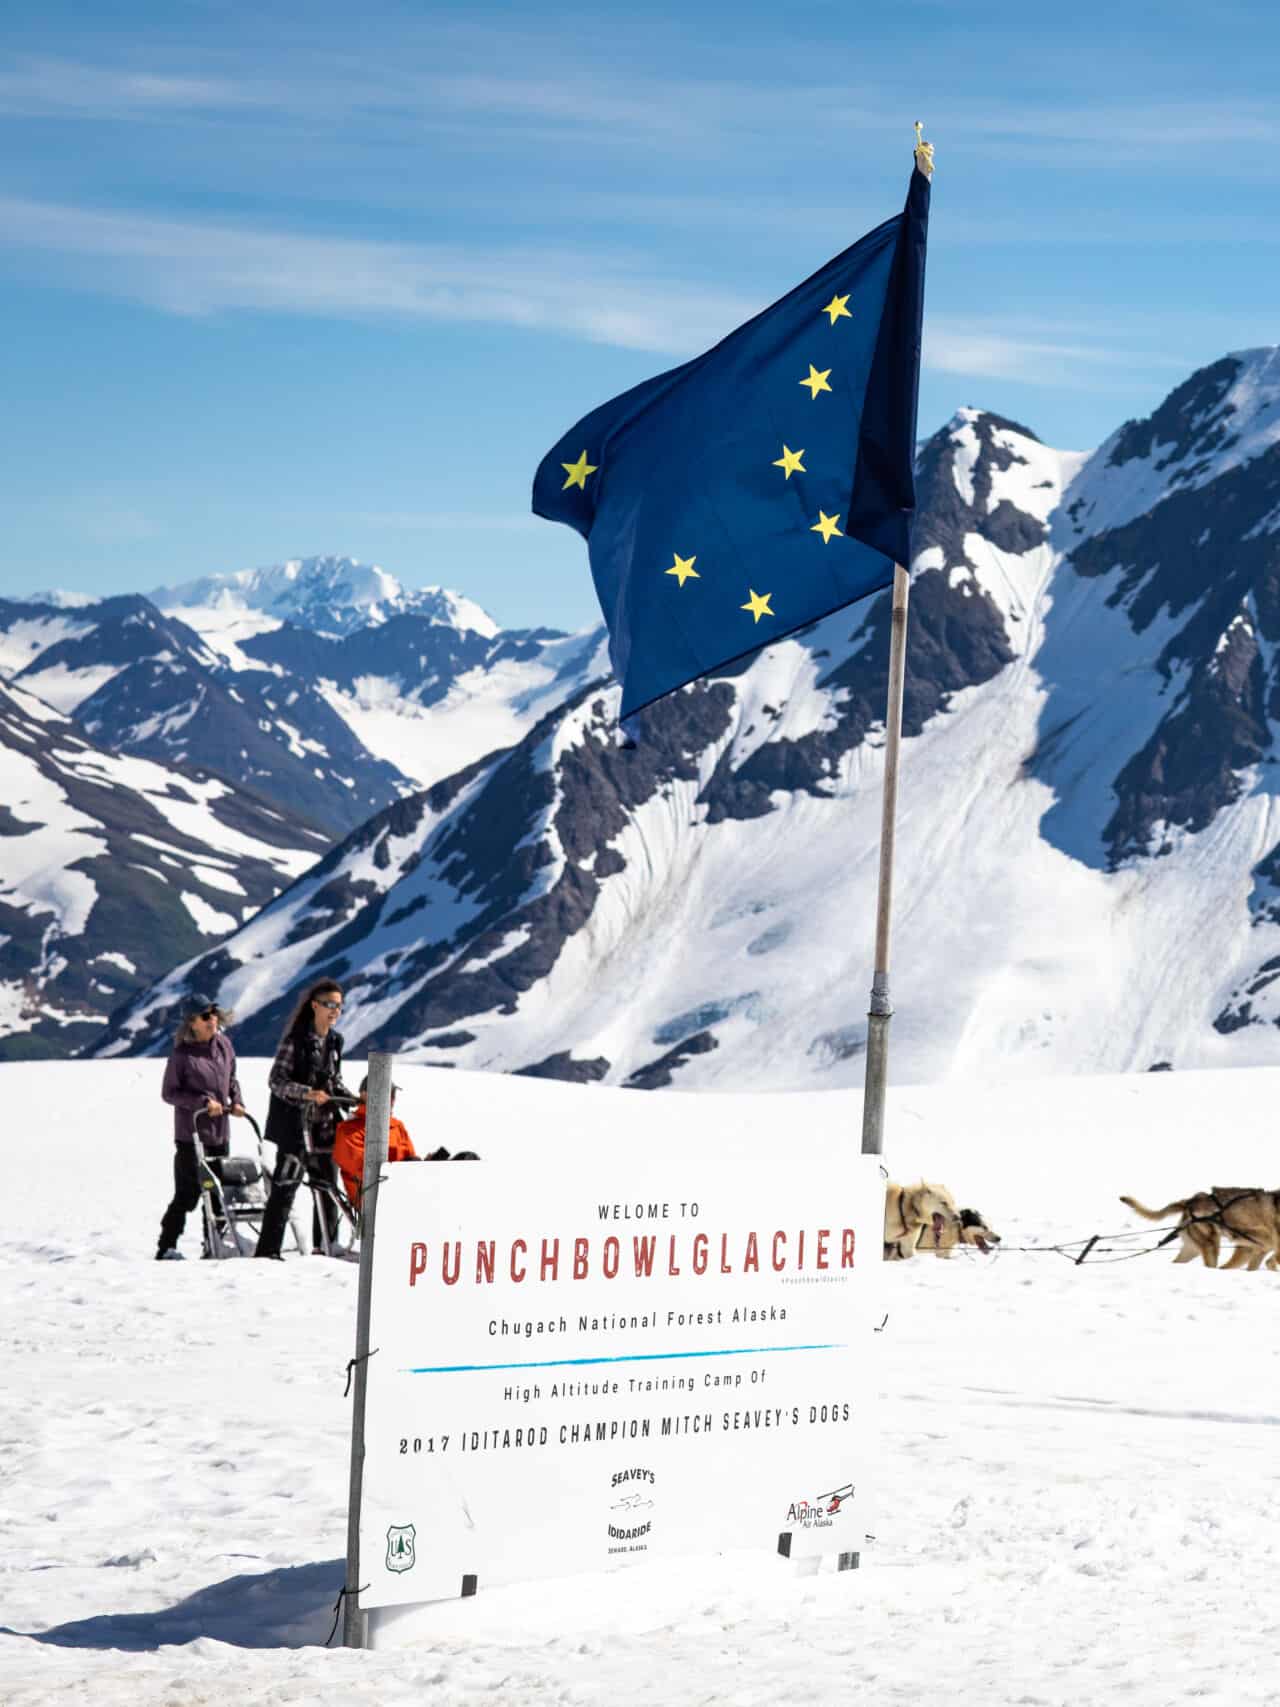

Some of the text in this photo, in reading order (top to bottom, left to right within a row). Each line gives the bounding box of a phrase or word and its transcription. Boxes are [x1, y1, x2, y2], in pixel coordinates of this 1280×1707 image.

[597, 1202, 699, 1220] WELOME TO
[408, 1228, 856, 1288] PUNCHBOWLGLACIER
[488, 1305, 787, 1339] Chugach National Forest Alaska
[503, 1369, 766, 1403] High Altitude Training Camp Of
[399, 1403, 849, 1455] 2017 IDITAROD CHAMPION MITCH SEAVEY'S DOGS
[611, 1468, 655, 1488] SEAVEY'S
[786, 1502, 823, 1524] Alpine
[607, 1520, 652, 1540] IDIDARIDE
